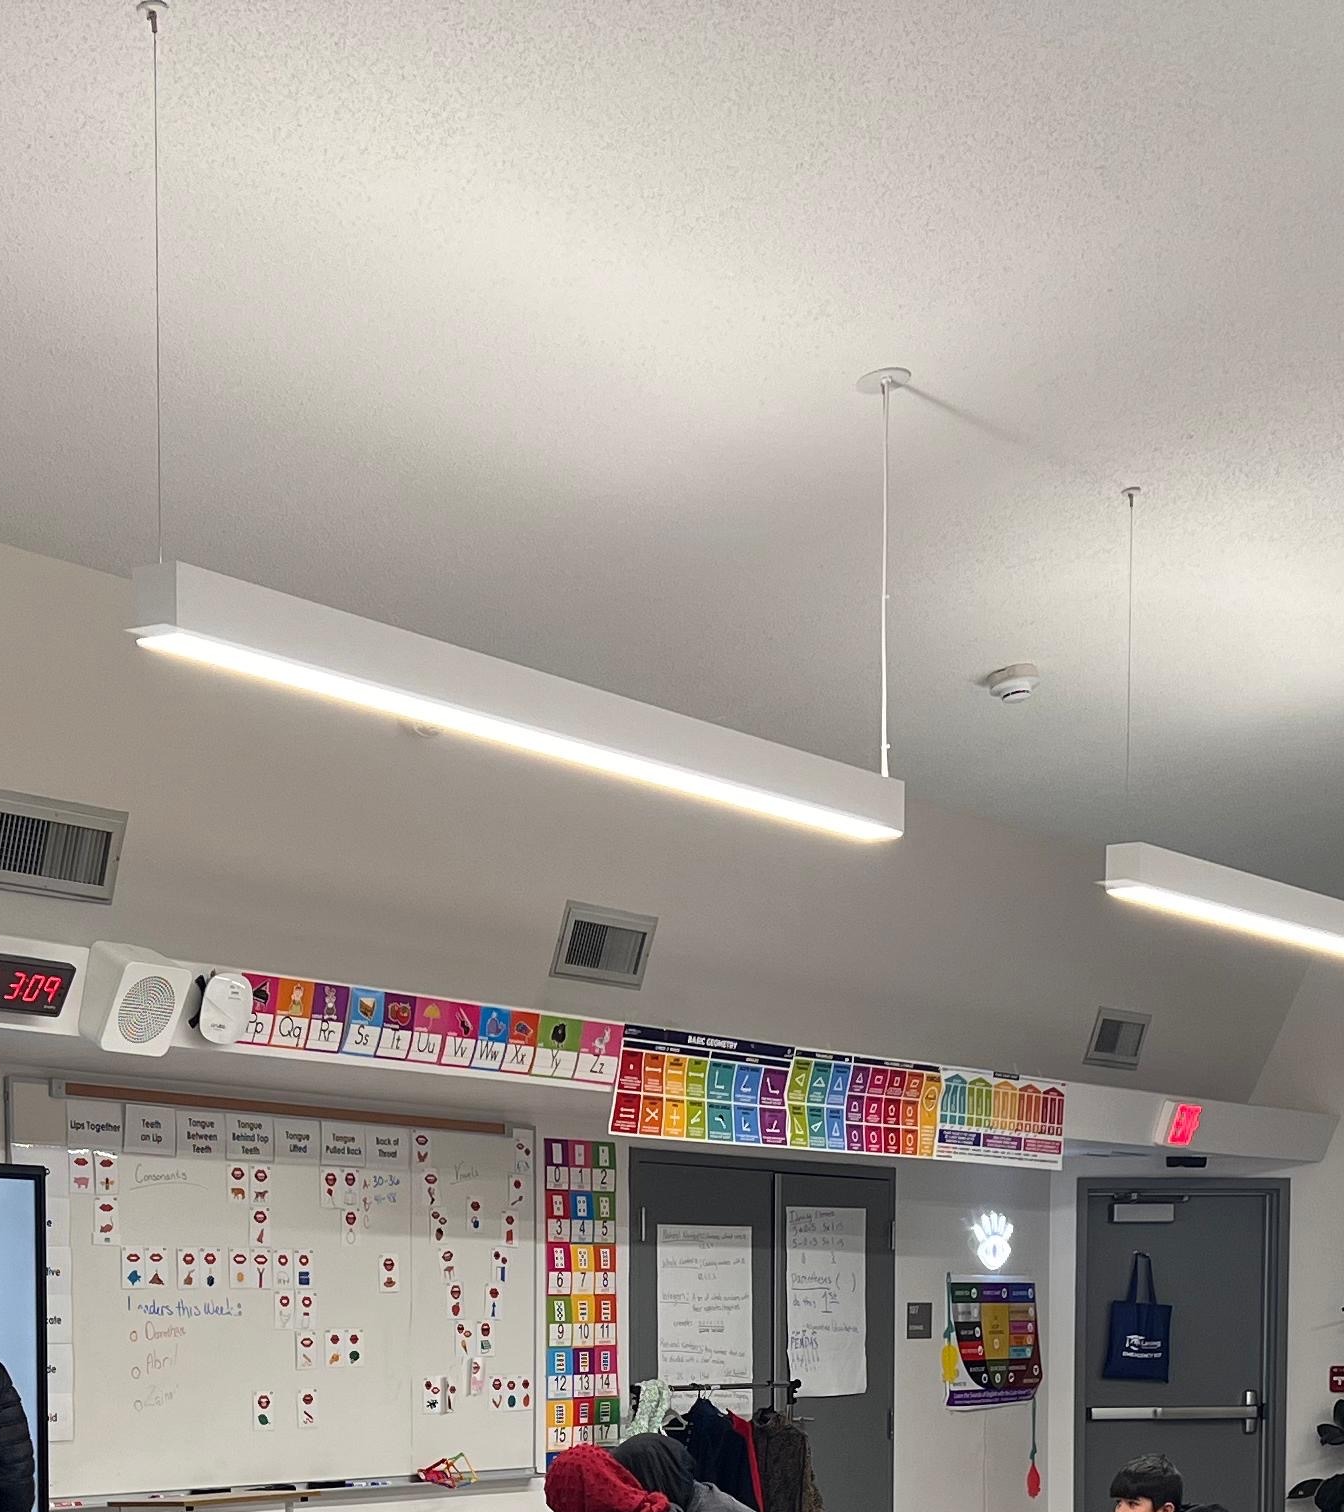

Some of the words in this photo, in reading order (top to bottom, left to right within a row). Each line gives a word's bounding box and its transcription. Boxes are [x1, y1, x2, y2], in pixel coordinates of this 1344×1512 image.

[4, 971, 63, 1003] 3:09
[279, 1016, 303, 1048] Qq
[318, 1019, 336, 1042] Rr
[355, 1024, 369, 1046] Ss
[390, 1028, 402, 1049] Tt
[417, 1032, 436, 1054] Uu
[453, 1037, 467, 1058] Vv
[480, 1039, 499, 1061] Ww
[510, 1044, 526, 1065] Xx
[550, 1049, 561, 1077] Yy
[589, 1053, 605, 1074] Zz
[70, 1120, 85, 1131] Lips
[87, 1121, 121, 1133] Together
[142, 1119, 162, 1129] Teeth
[188, 1118, 215, 1131] Tongue
[237, 1120, 263, 1132] Tongue
[186, 1131, 218, 1141] Between
[232, 1132, 256, 1142] Behind
[256, 1133, 269, 1144] Top
[285, 1131, 310, 1143] Tongue
[332, 1133, 356, 1145] Tongue
[375, 1136, 390, 1147] Back
[192, 1144, 212, 1153] Teeth
[241, 1146, 261, 1155] Teeth
[289, 1144, 307, 1154] Lifted
[325, 1144, 346, 1155] Pulled
[554, 1167, 561, 1183] 0
[578, 1169, 584, 1183] 1
[600, 1169, 607, 1185] 2
[555, 1219, 563, 1235] 3
[579, 1220, 585, 1236] 4
[601, 1221, 608, 1236] 5
[556, 1272, 564, 1288] 6
[580, 1272, 586, 1288] 7
[602, 1272, 609, 1288] 8
[176, 1299, 201, 1318] this
[557, 1324, 564, 1339] 9
[578, 1324, 589, 1339] 10
[600, 1324, 610, 1339] 11
[554, 1375, 567, 1391] 12
[579, 1375, 590, 1390] 13
[600, 1375, 610, 1389] 14
[554, 1427, 566, 1442] 15
[578, 1426, 588, 1441] 16
[599, 1424, 610, 1440] 17
